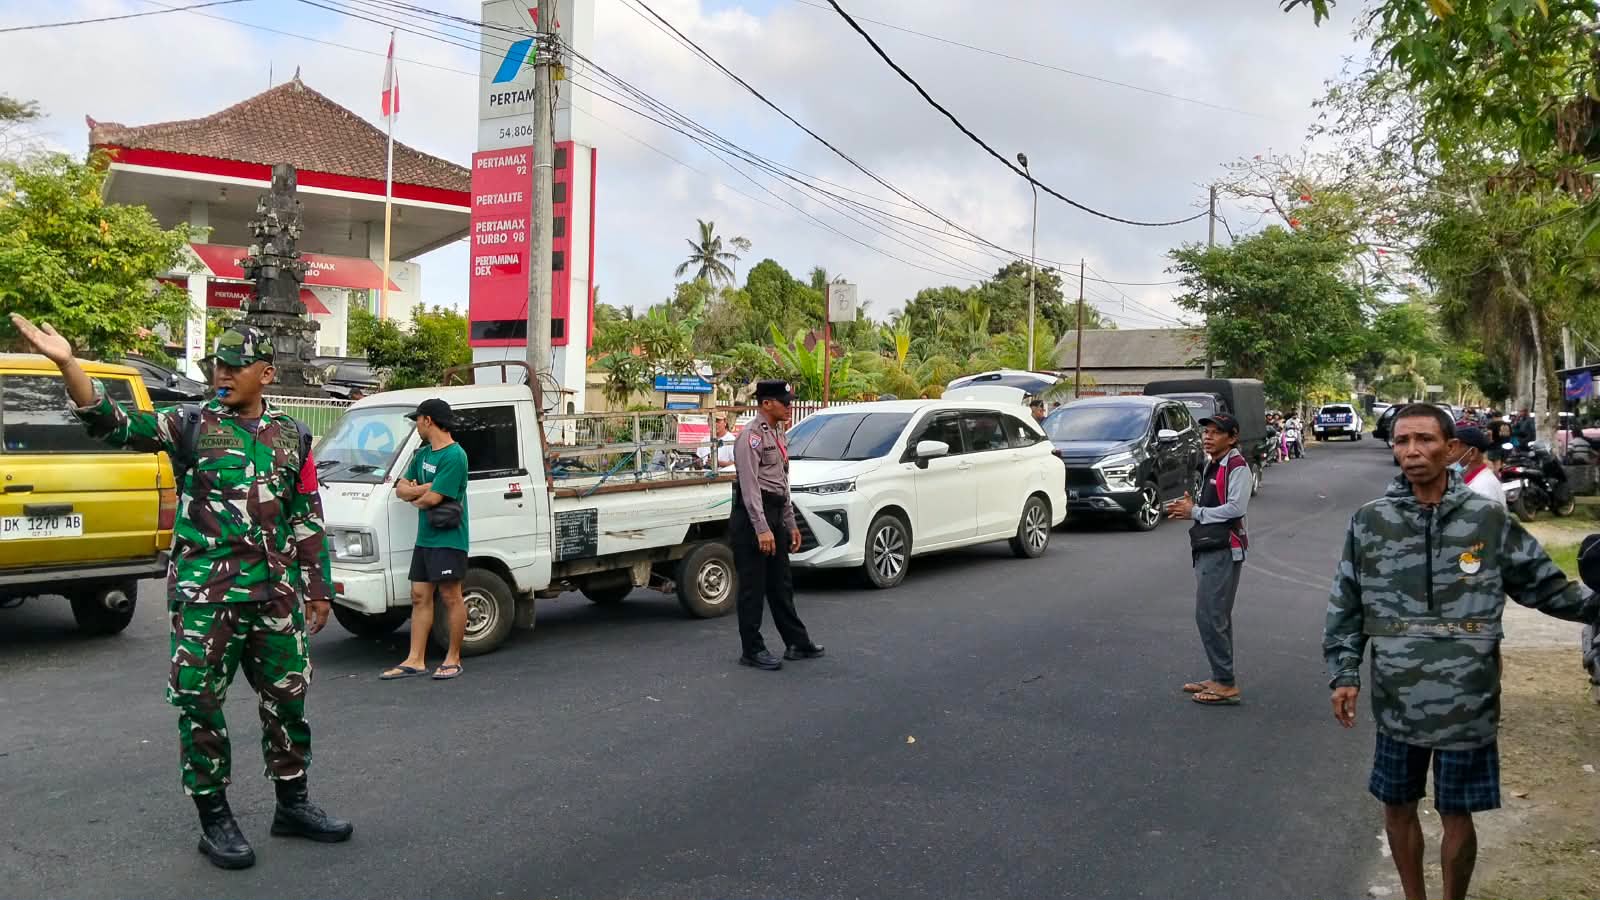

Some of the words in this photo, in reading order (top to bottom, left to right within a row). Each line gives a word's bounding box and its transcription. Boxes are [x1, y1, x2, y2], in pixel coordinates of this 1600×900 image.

[490, 88, 535, 107] PERTAM
[477, 153, 527, 169] PERTAMAX
[516, 165, 527, 175] 92
[476, 191, 523, 206] PERTALITE
[475, 219, 525, 233] PERTAMAX
[476, 233, 508, 245] TURBO
[512, 232, 525, 243] 98
[475, 254, 519, 266] PERTAMINA
[475, 266, 492, 276] DEX
[4, 518, 19, 532] DK
[27, 516, 59, 530] 1270
[65, 516, 81, 529] AB
